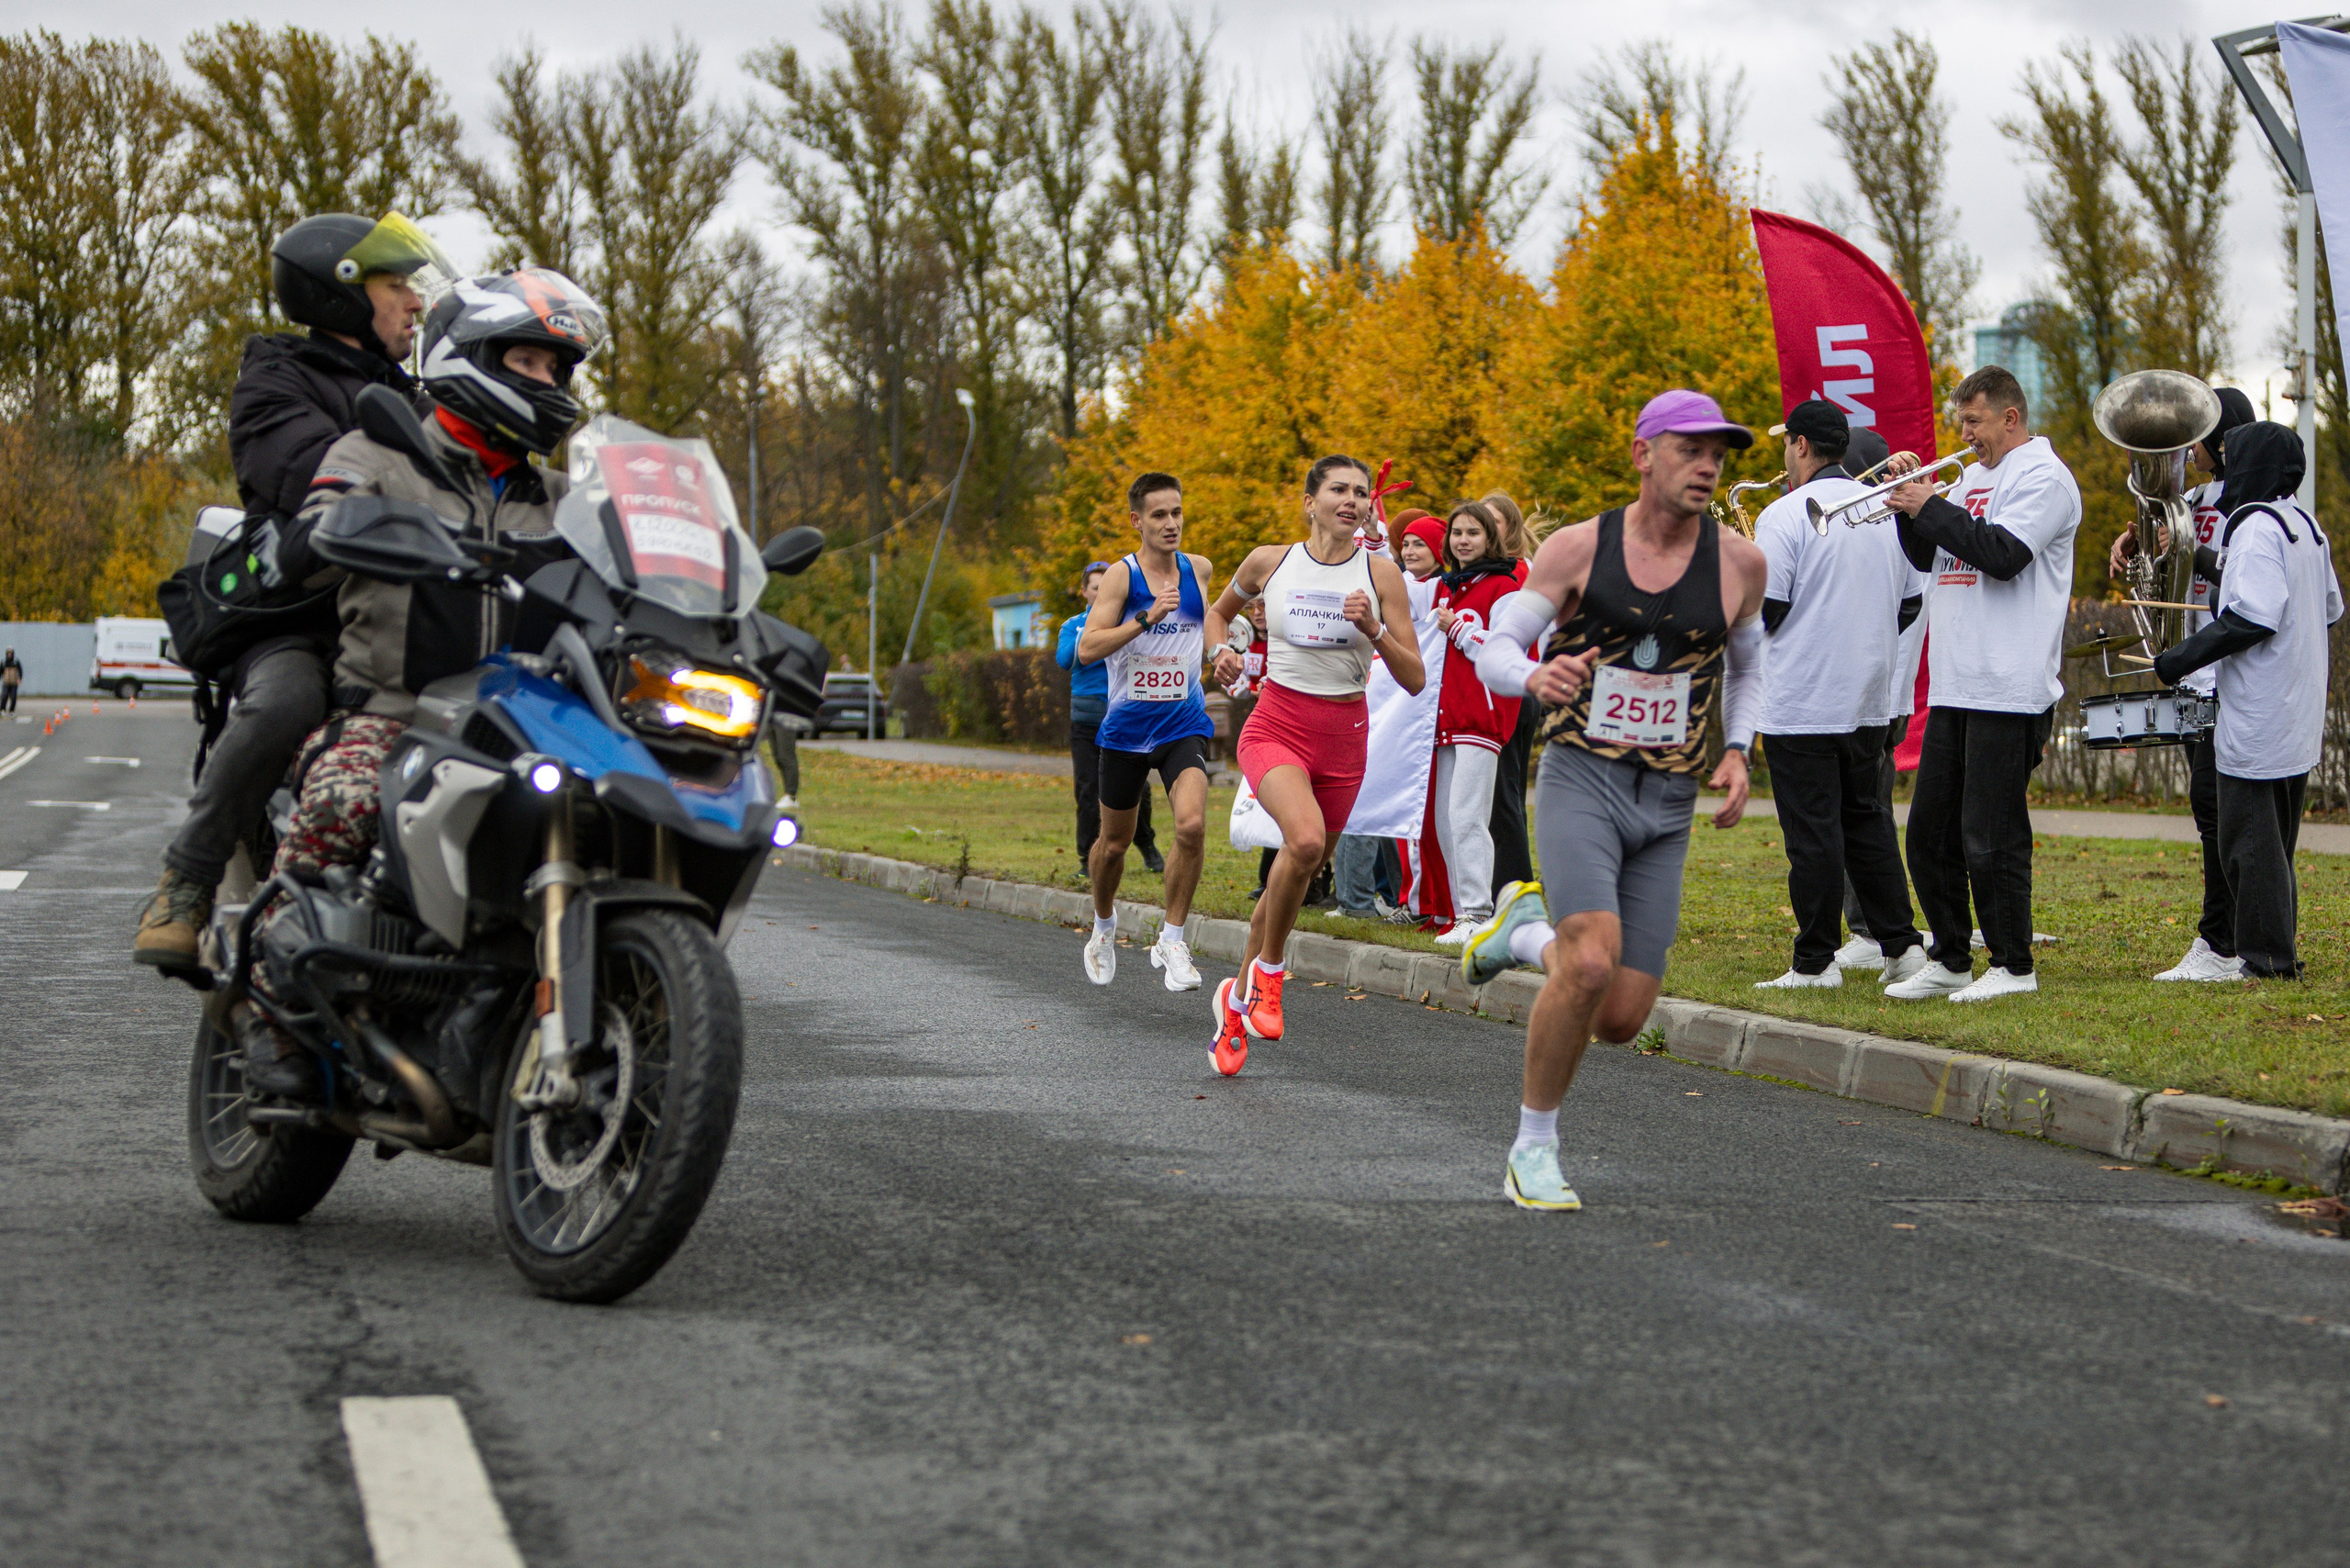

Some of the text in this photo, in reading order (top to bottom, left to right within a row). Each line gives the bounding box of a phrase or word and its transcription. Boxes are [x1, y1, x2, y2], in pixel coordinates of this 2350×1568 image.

[621, 493, 701, 514] ПРОПУСК
[1289, 608, 1350, 622] АПЛАЧКИН
[1147, 623, 1178, 634] ISIS
[1134, 671, 1184, 687] 2820
[1606, 693, 1676, 724] 2512
